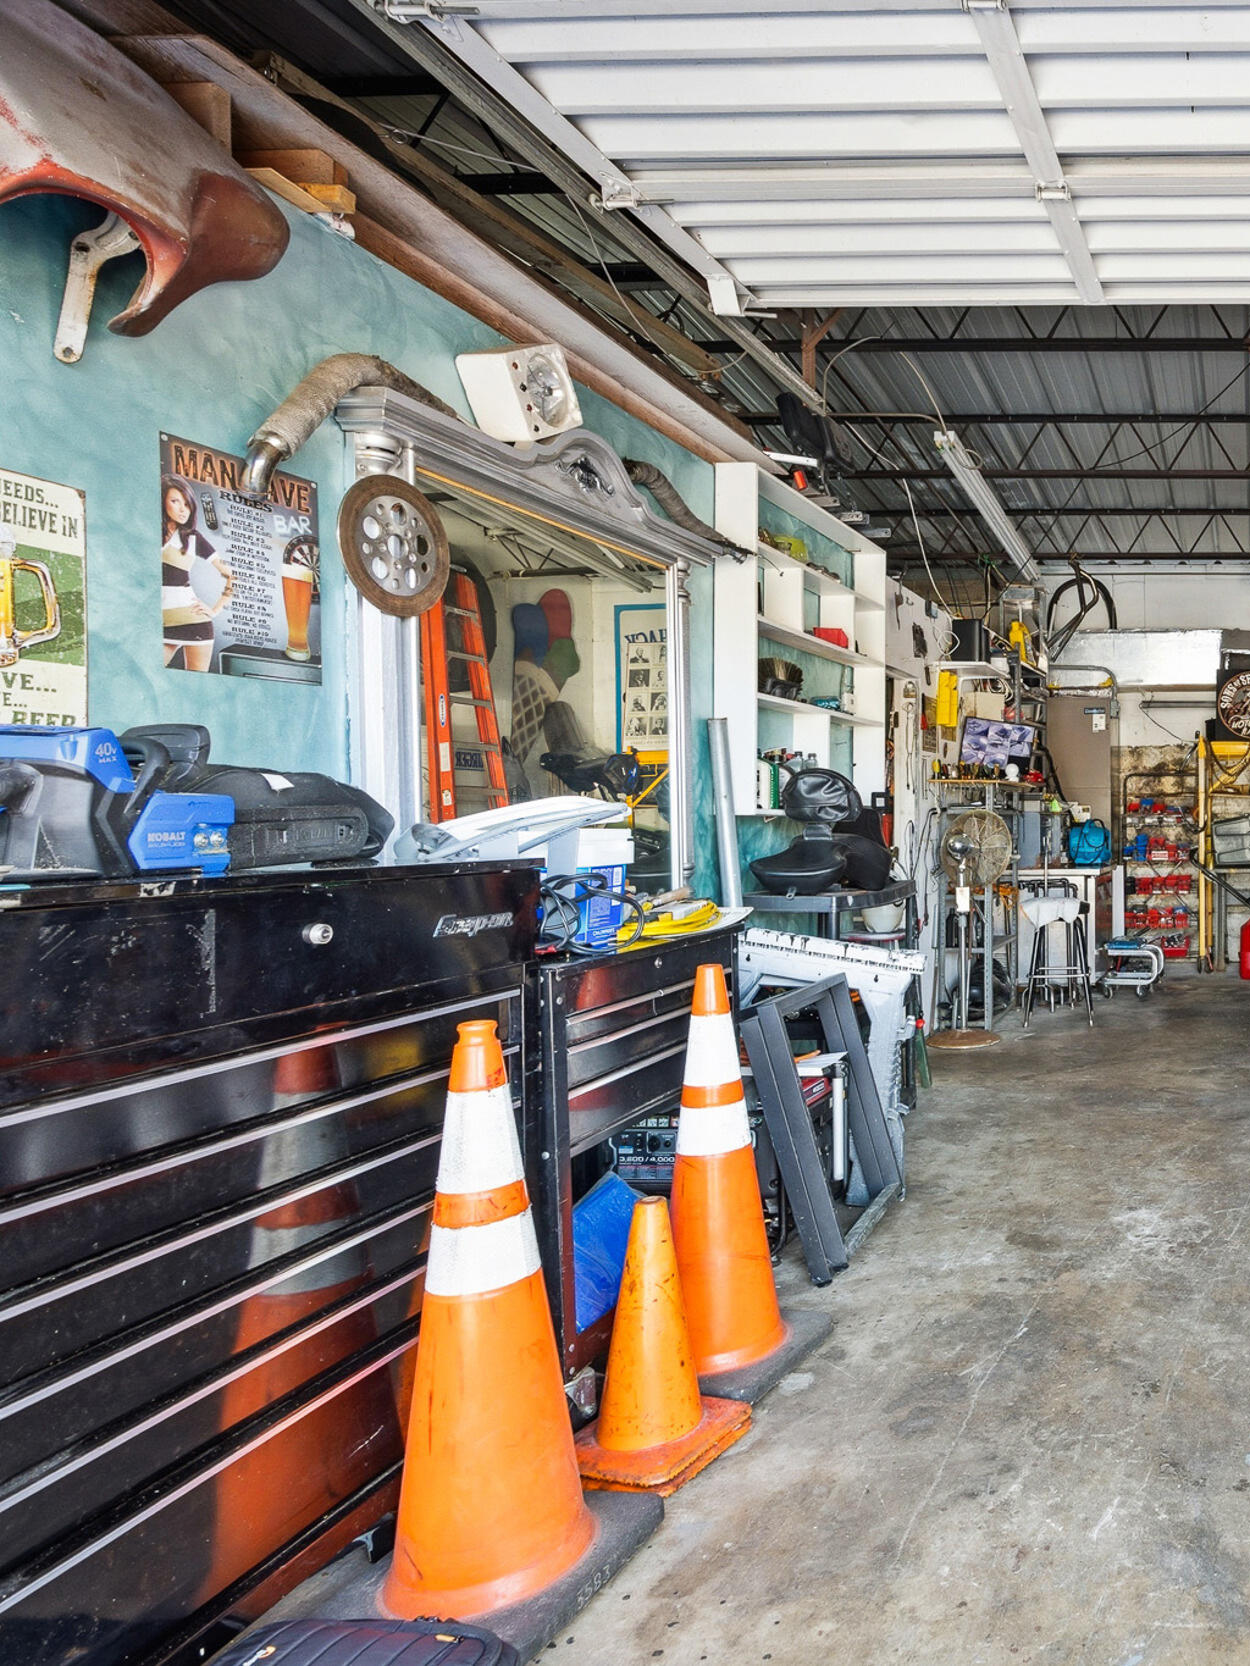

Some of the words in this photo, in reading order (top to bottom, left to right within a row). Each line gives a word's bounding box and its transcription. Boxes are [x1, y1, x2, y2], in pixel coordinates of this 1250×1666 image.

[0, 478, 59, 508] EEDS...
[174, 445, 238, 491] MAN
[267, 474, 311, 513] AVE
[0, 500, 57, 534] ELIEVE
[62, 515, 78, 539] IN
[273, 515, 312, 535] BAR
[147, 831, 186, 843] KOBALT
